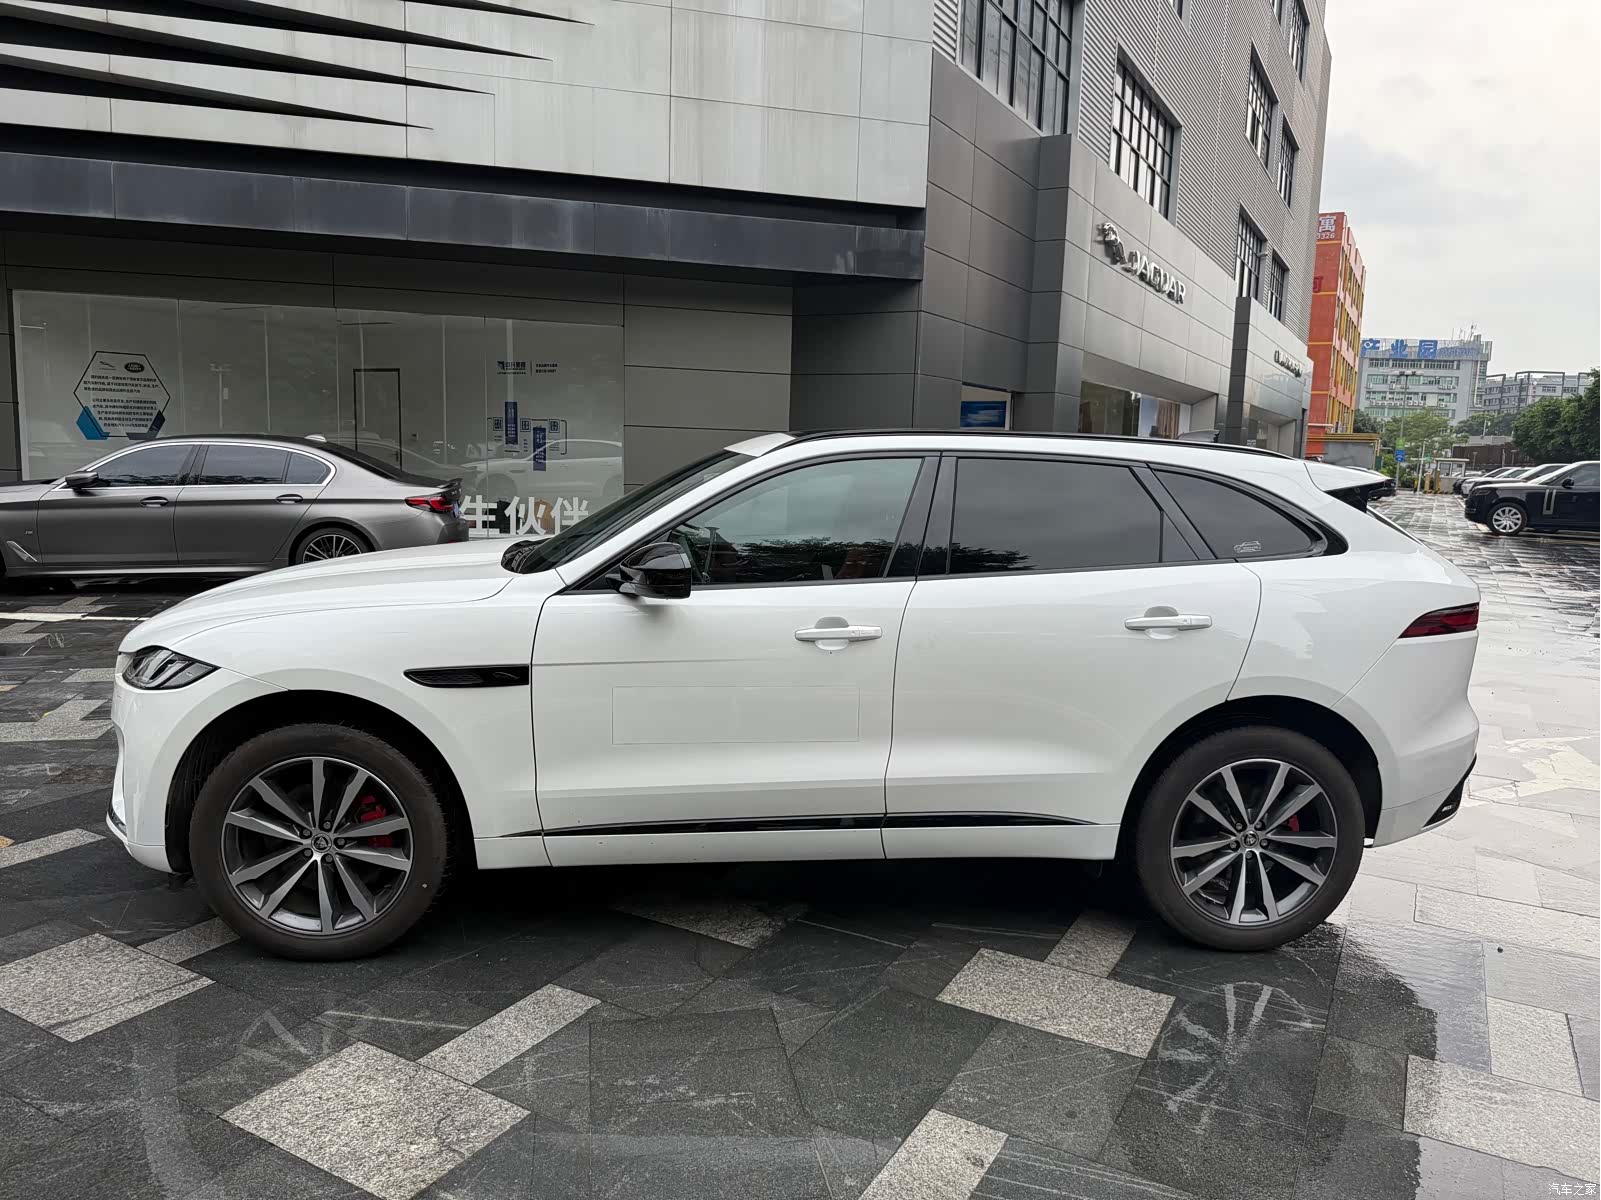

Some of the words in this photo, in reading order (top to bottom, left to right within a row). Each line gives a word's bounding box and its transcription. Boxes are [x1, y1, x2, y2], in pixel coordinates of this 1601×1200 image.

[1125, 250, 1186, 303] JAGUAR
[1360, 338, 1438, 359] 产业园
[459, 495, 588, 536] 生伙伴
